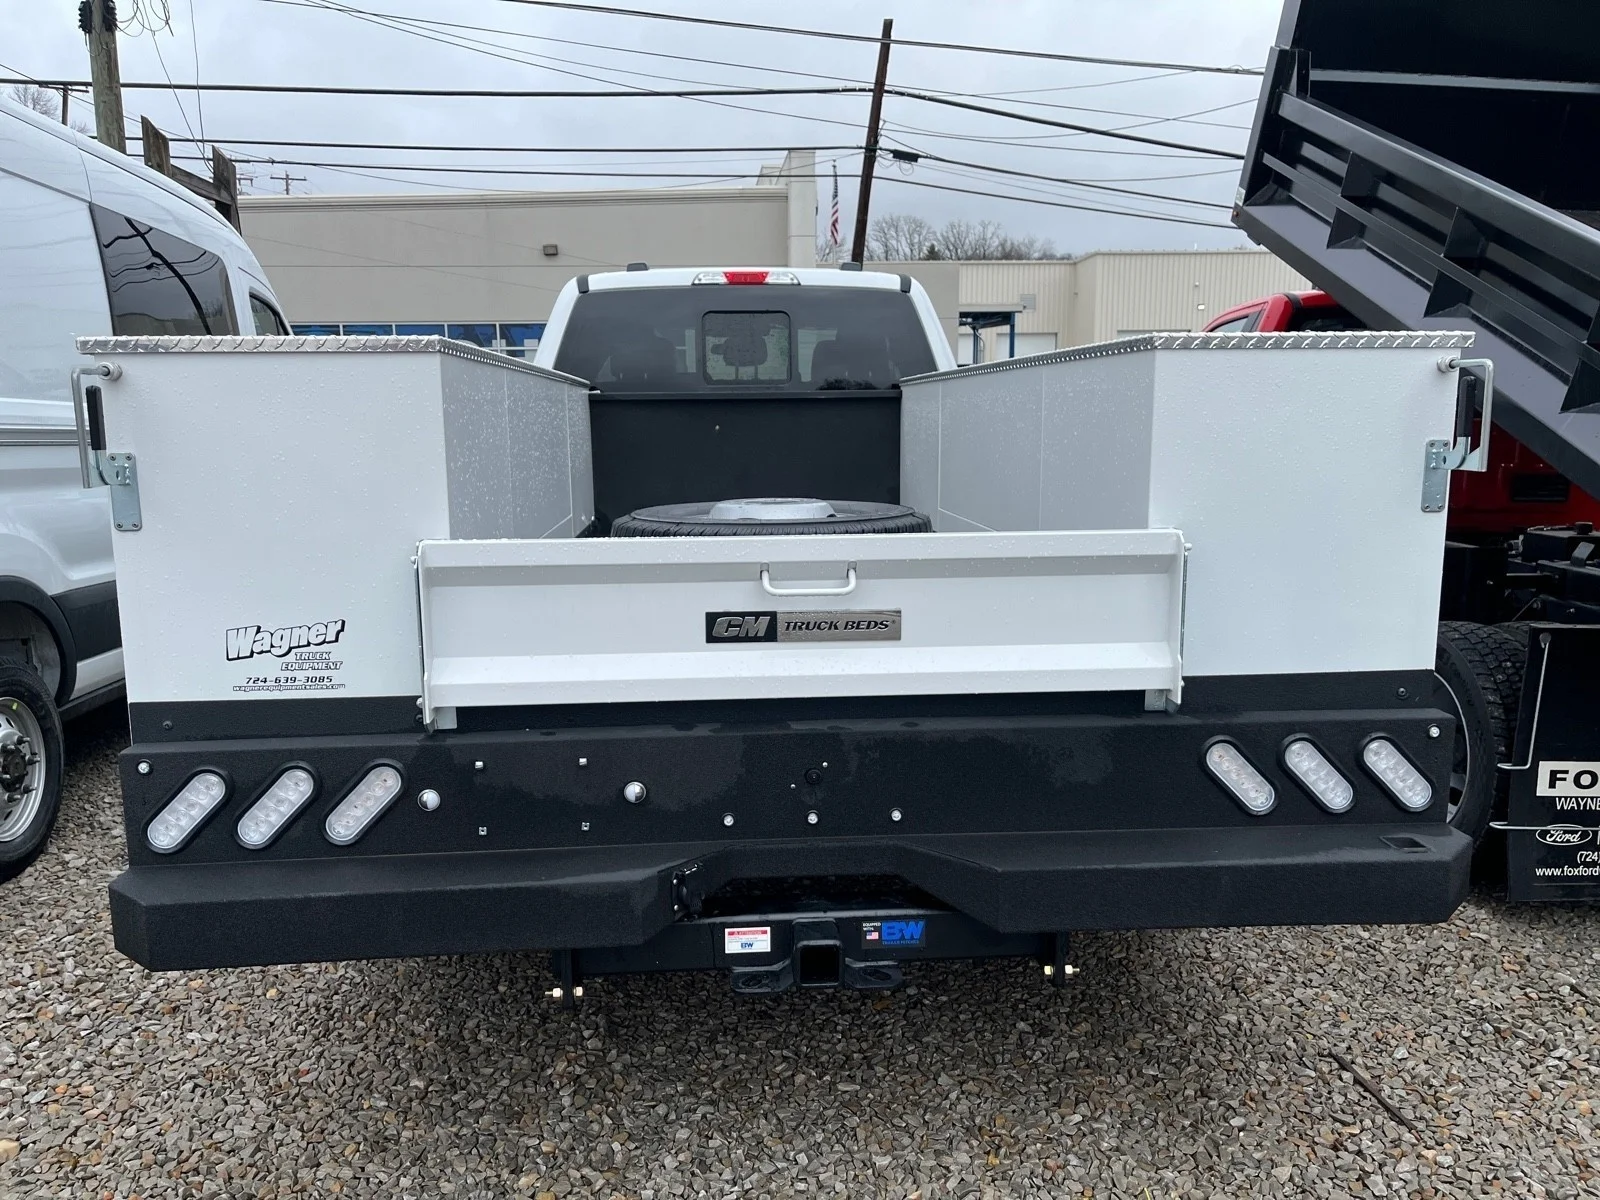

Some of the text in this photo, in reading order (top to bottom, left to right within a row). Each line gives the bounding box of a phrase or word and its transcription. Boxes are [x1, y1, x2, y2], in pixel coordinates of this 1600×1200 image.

[712, 616, 771, 637] CM
[784, 621, 840, 631] TRUCK
[226, 619, 346, 661] Wagner
[295, 651, 332, 661] TRUCK
[280, 661, 343, 671] EQUIPMENT
[245, 676, 333, 684] 724-639-3085
[233, 684, 346, 692] wagnerequipmentsales.com
[1545, 829, 1582, 843] Ford
[1535, 864, 1600, 876] www.foxford
